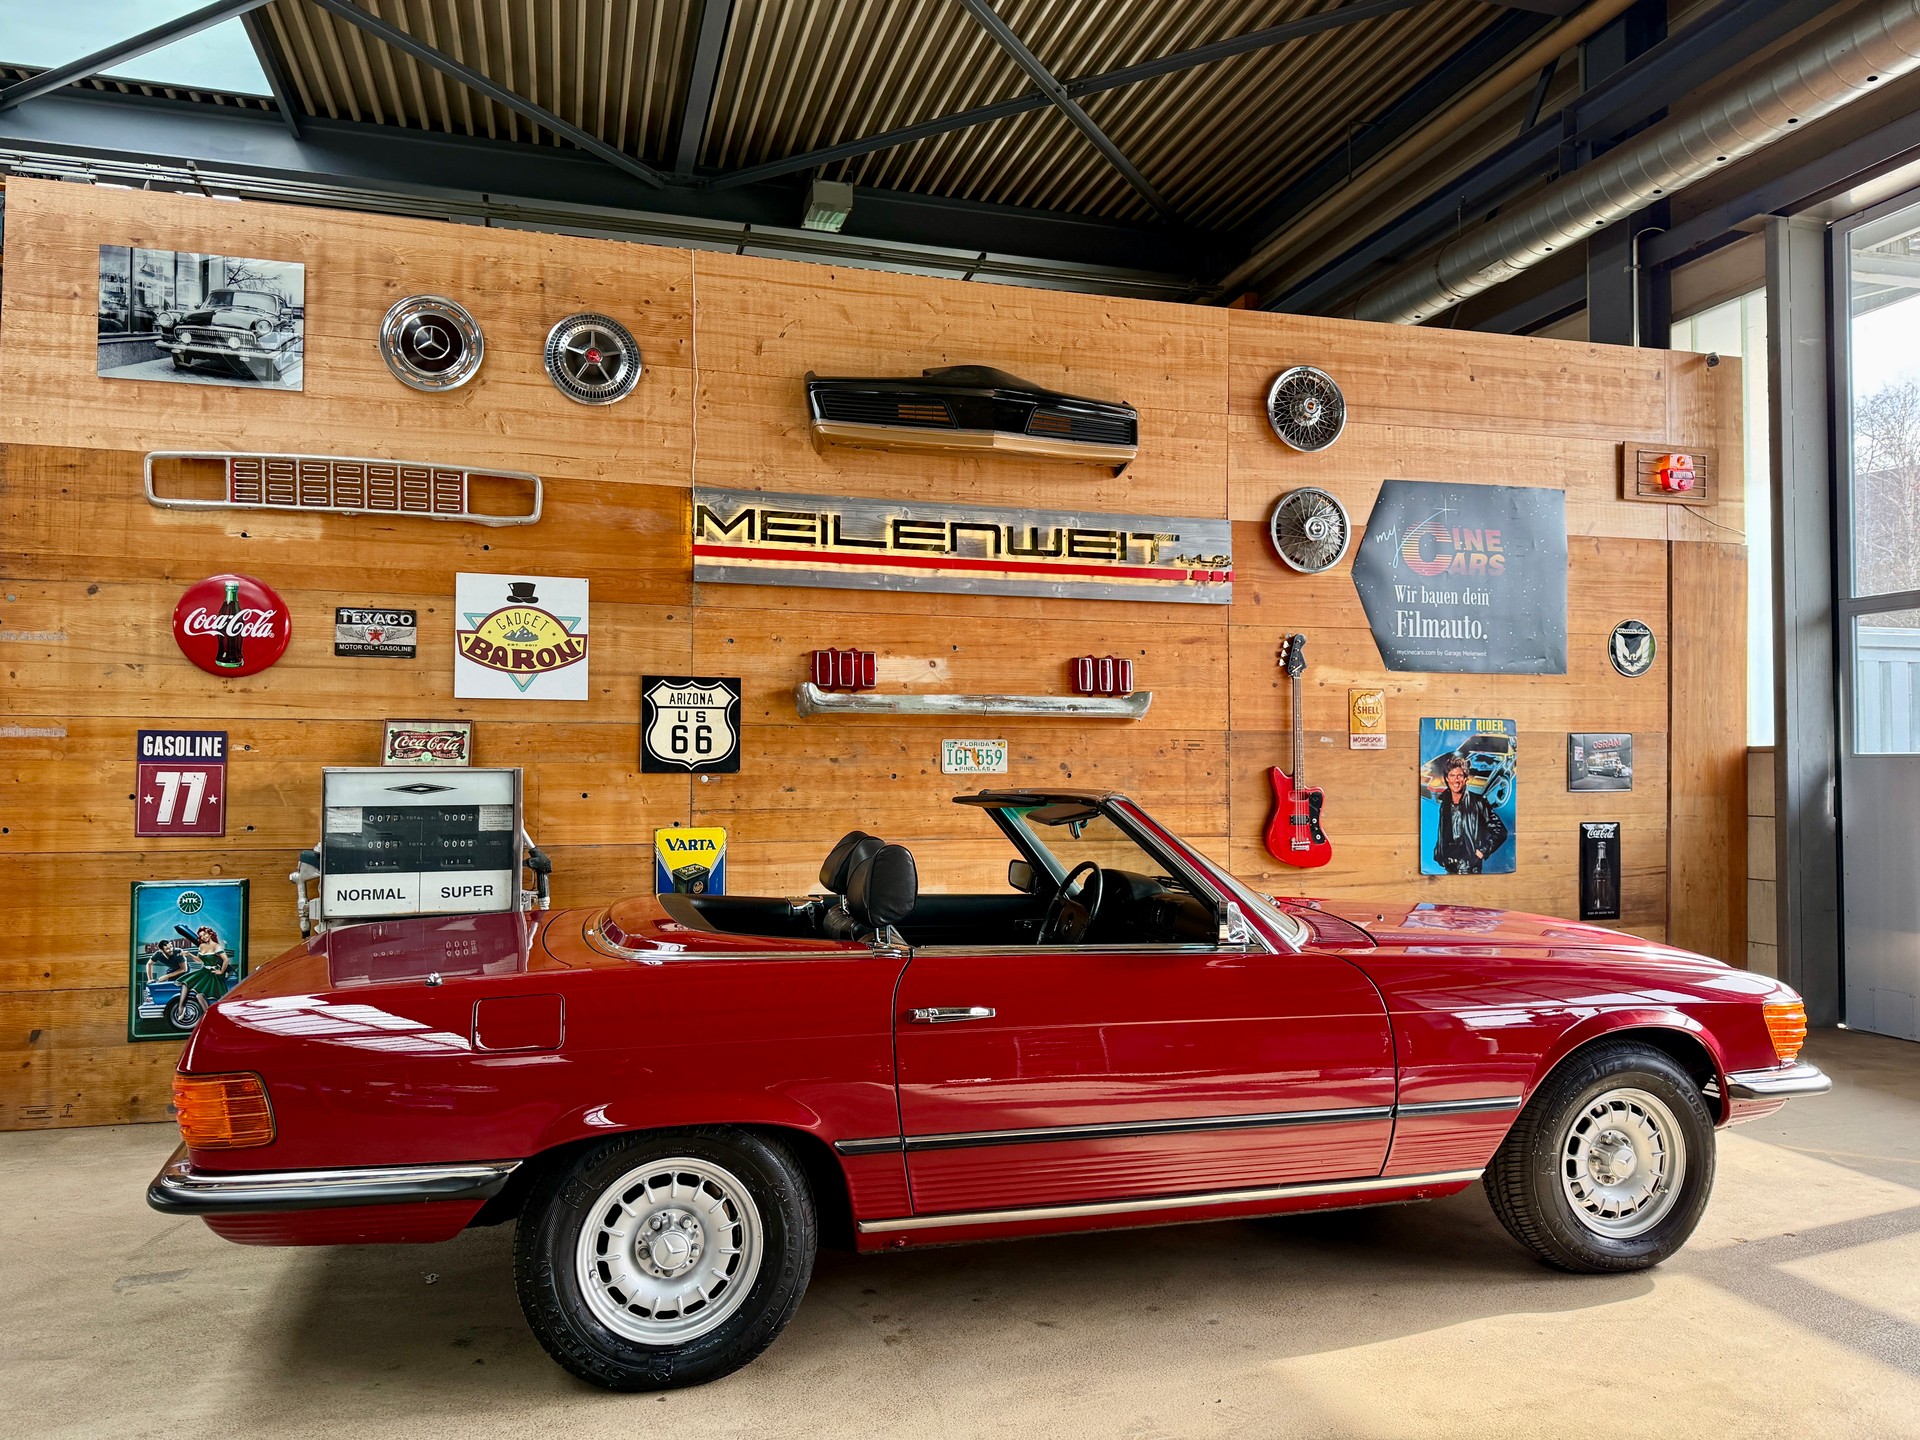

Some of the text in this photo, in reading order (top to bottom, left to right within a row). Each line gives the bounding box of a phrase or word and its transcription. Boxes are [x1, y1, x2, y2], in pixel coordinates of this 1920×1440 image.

[696, 504, 1181, 564] MEILENWEIT
[1394, 584, 1489, 606] Wir bauen dein
[340, 611, 413, 626] TEXACO
[495, 612, 550, 632] GADGET
[1395, 610, 1488, 640] Filmauto.
[465, 636, 582, 669] BARON
[669, 692, 714, 705] ARIZONA
[1357, 706, 1380, 714] SHELL
[1435, 719, 1472, 731] KNIGHT
[143, 735, 222, 757] GASOLINE
[671, 725, 712, 754] 66
[1592, 738, 1621, 749] OSRAM
[665, 838, 716, 851] VARTA
[337, 885, 494, 901] NORMAL SUPER
